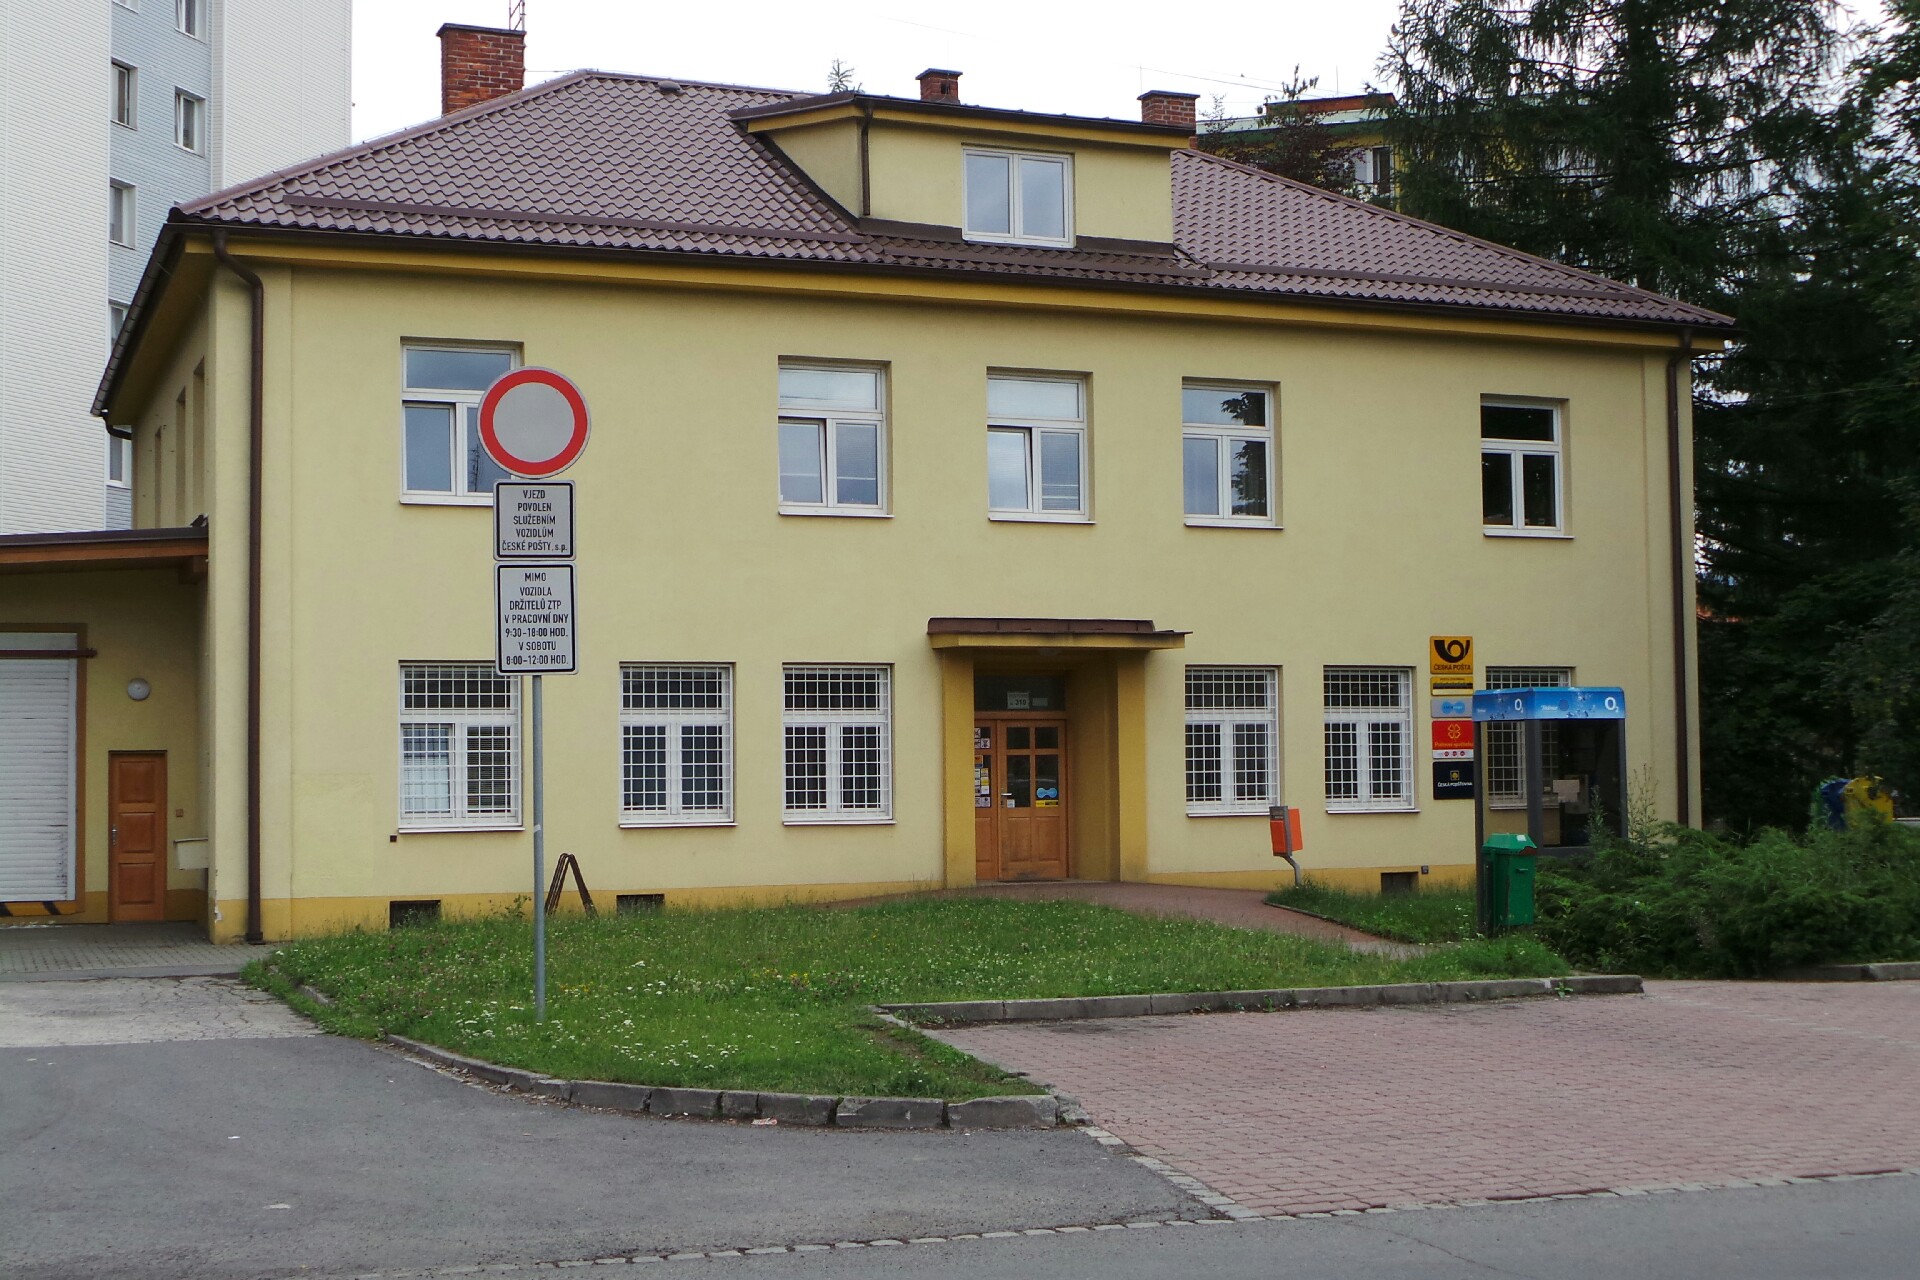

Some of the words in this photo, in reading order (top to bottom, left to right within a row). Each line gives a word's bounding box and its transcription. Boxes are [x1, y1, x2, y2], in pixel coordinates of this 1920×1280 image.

[523, 489, 546, 499] VJEZD
[517, 502, 552, 512] POVOLEN
[513, 513, 556, 525] SLUŽEBNÍM
[502, 539, 526, 551] ČESKÉ
[524, 572, 547, 582] MIMO
[519, 586, 552, 596] VOZIDLA
[510, 598, 546, 610] DRŽITELŮ
[547, 599, 562, 610] ZTP
[504, 614, 510, 624] V
[511, 611, 552, 624] PRACOVNÍ
[552, 613, 569, 624] DNY
[550, 627, 569, 637] HOD.
[518, 641, 524, 651] V
[526, 641, 557, 651] SOBOTU
[550, 654, 569, 665] HOD.
